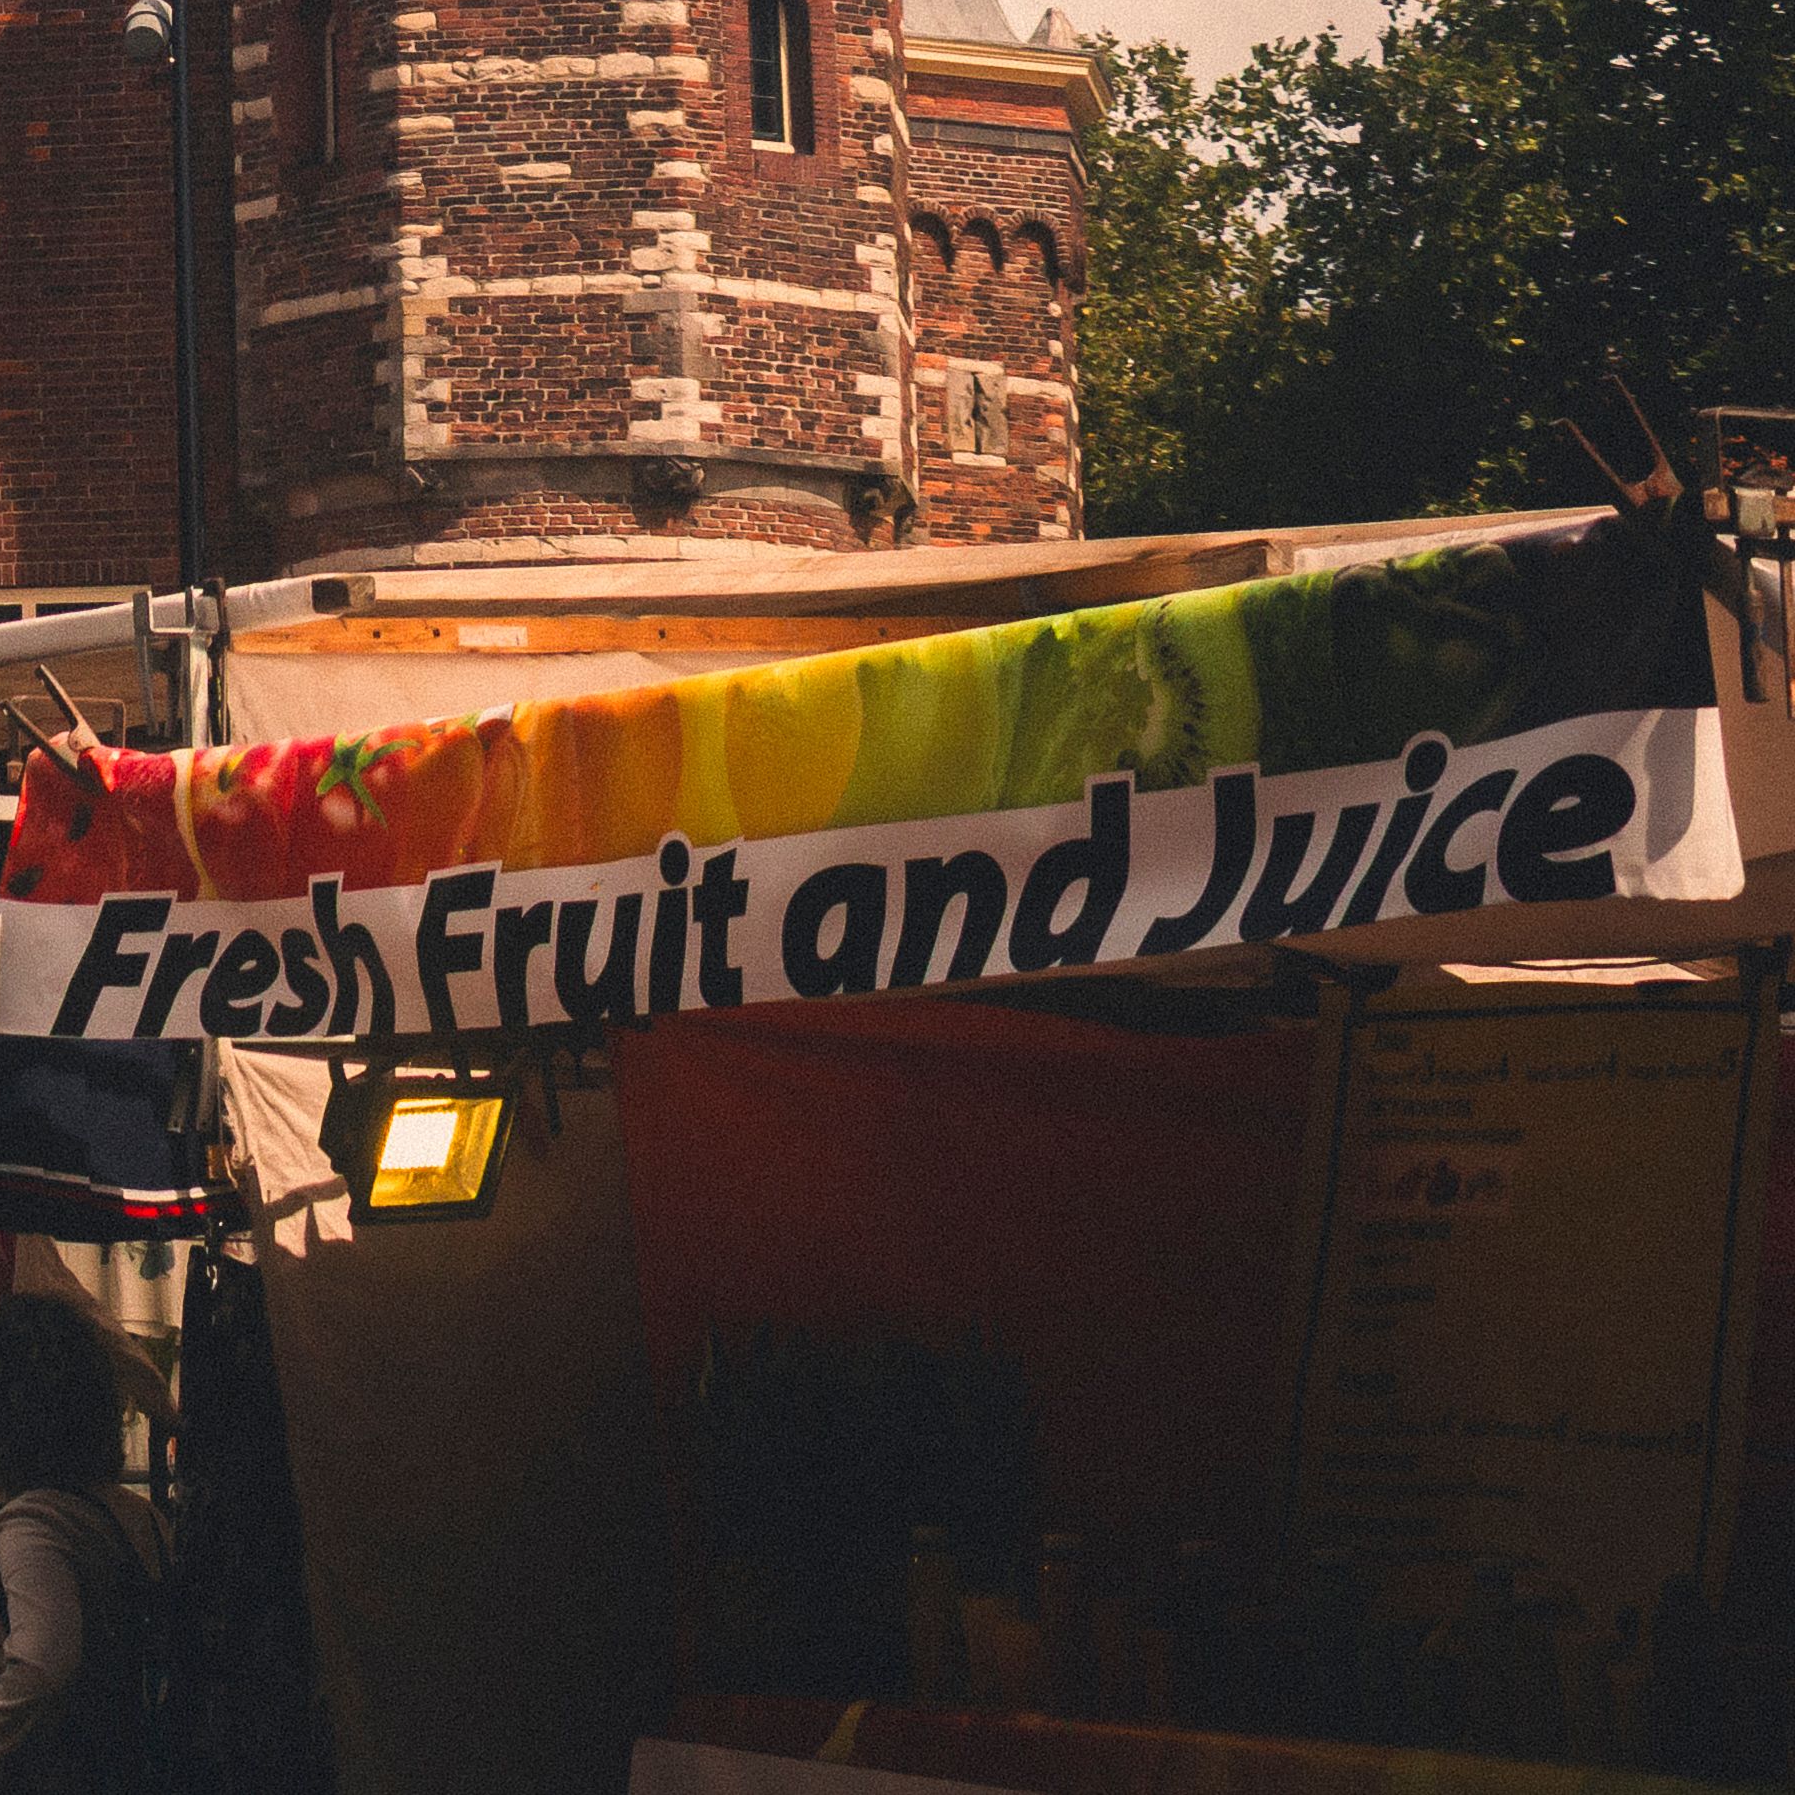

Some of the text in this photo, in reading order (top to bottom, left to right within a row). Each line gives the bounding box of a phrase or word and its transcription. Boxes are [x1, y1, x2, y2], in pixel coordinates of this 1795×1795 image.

[50, 739, 1637, 1037] Fresh Fruit and Juice
